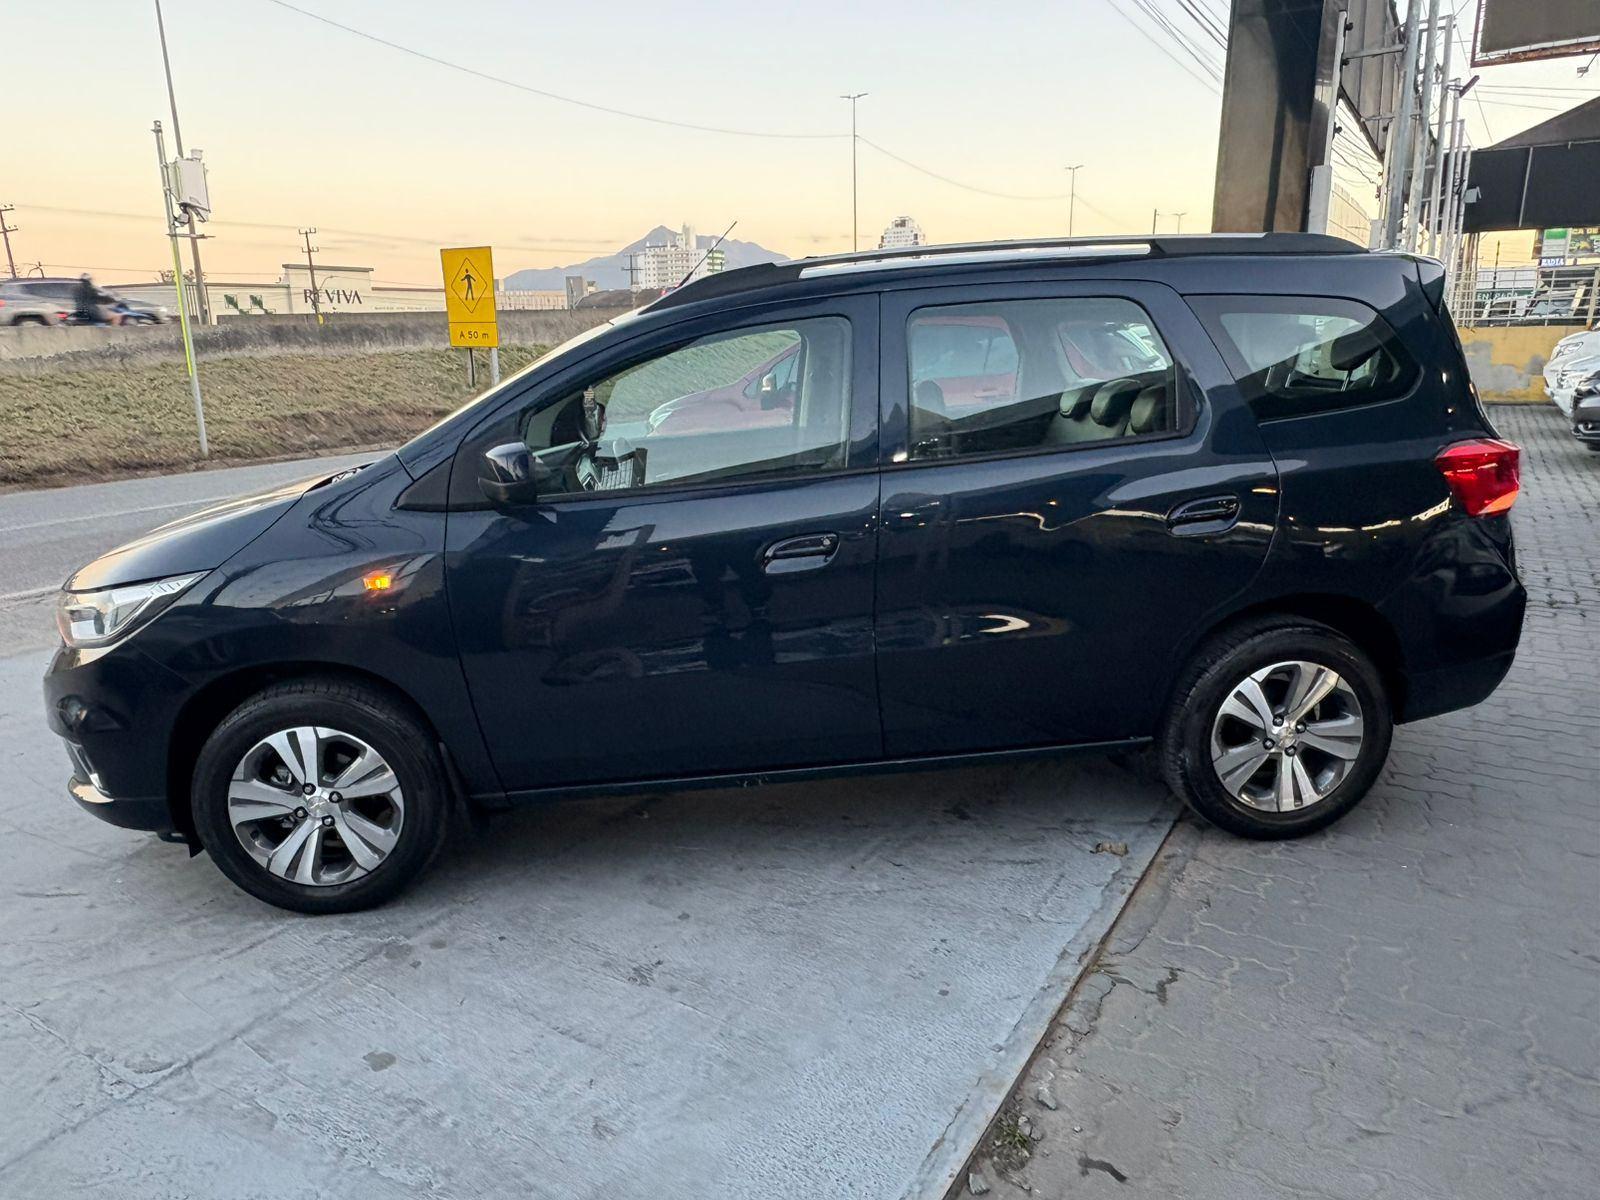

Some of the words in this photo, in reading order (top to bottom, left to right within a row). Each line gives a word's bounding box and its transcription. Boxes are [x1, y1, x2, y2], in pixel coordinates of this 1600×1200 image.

[303, 288, 362, 304] REVIVA
[459, 330, 465, 339] A
[467, 330, 479, 339] 50
